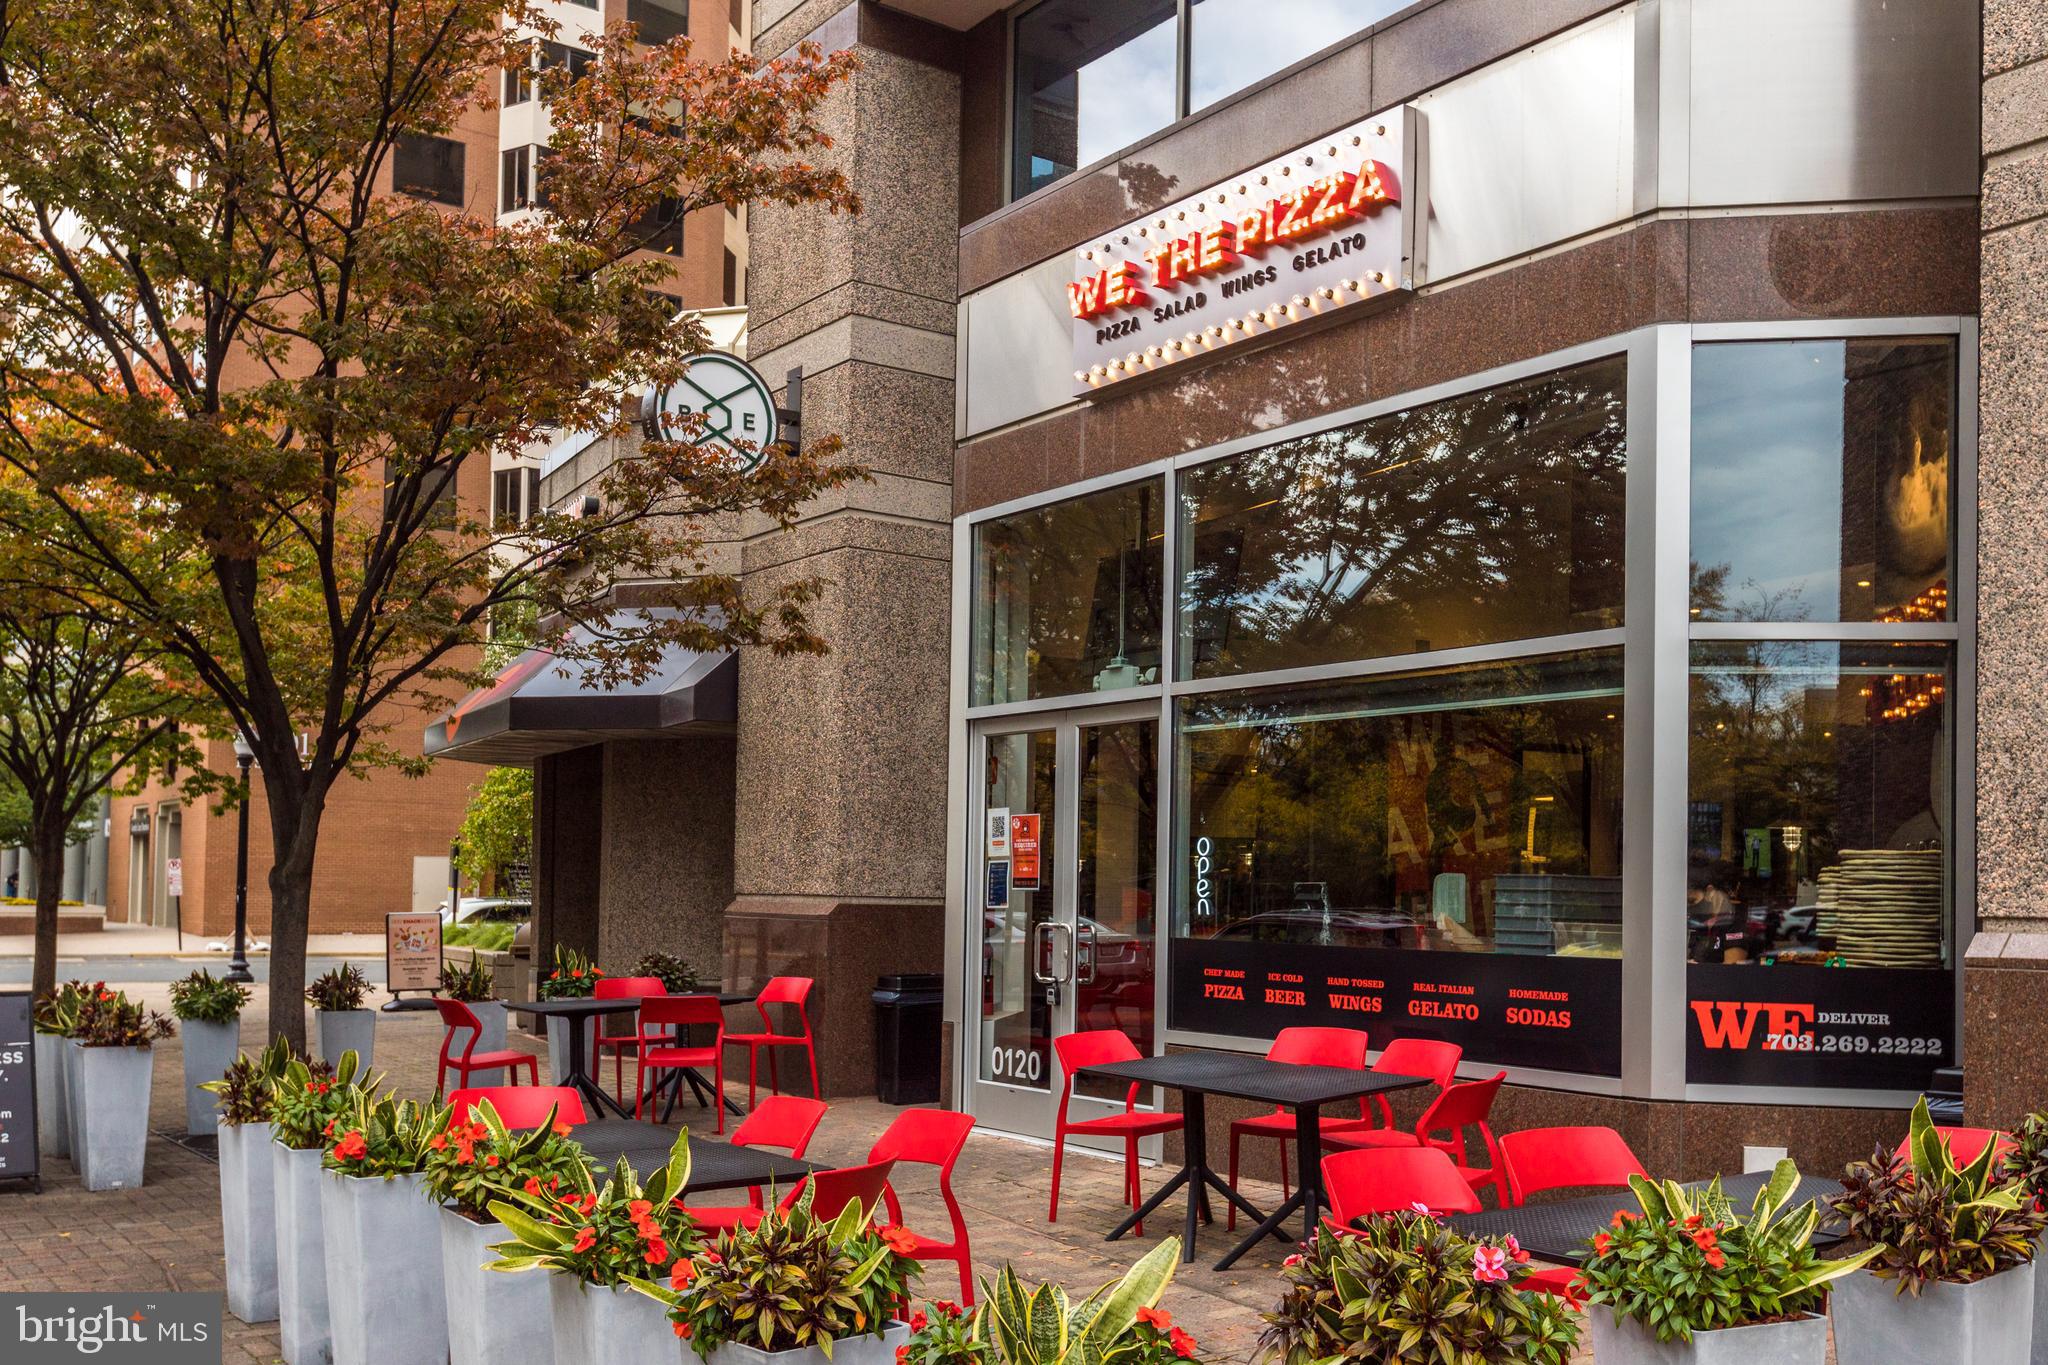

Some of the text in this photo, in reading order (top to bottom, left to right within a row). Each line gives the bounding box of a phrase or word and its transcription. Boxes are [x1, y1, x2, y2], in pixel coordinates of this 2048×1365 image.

[1144, 221, 1237, 288] THE
[1235, 159, 1398, 256] PIZZA
[1096, 233, 1366, 345] PIZZA SALAD WINGS GELATO
[1203, 968, 1245, 979] CHEF MADE
[1267, 973, 1303, 983] ICE COLD
[1327, 977, 1385, 989] HAND TOSSED
[1203, 983, 1245, 1001] PIZZA
[1264, 988, 1306, 1006] BEER
[1412, 982, 1475, 995] REAL ITALIAN
[1508, 988, 1569, 1002] HOMEMADE
[1328, 993, 1383, 1013] WINGS
[1407, 1000, 1480, 1021] GELATO
[1506, 1007, 1572, 1029] SODAS
[1690, 1000, 1890, 1050] WE DELIVER
[1766, 1033, 1942, 1055] 703.269.2222
[991, 1046, 1040, 1081] 0120
